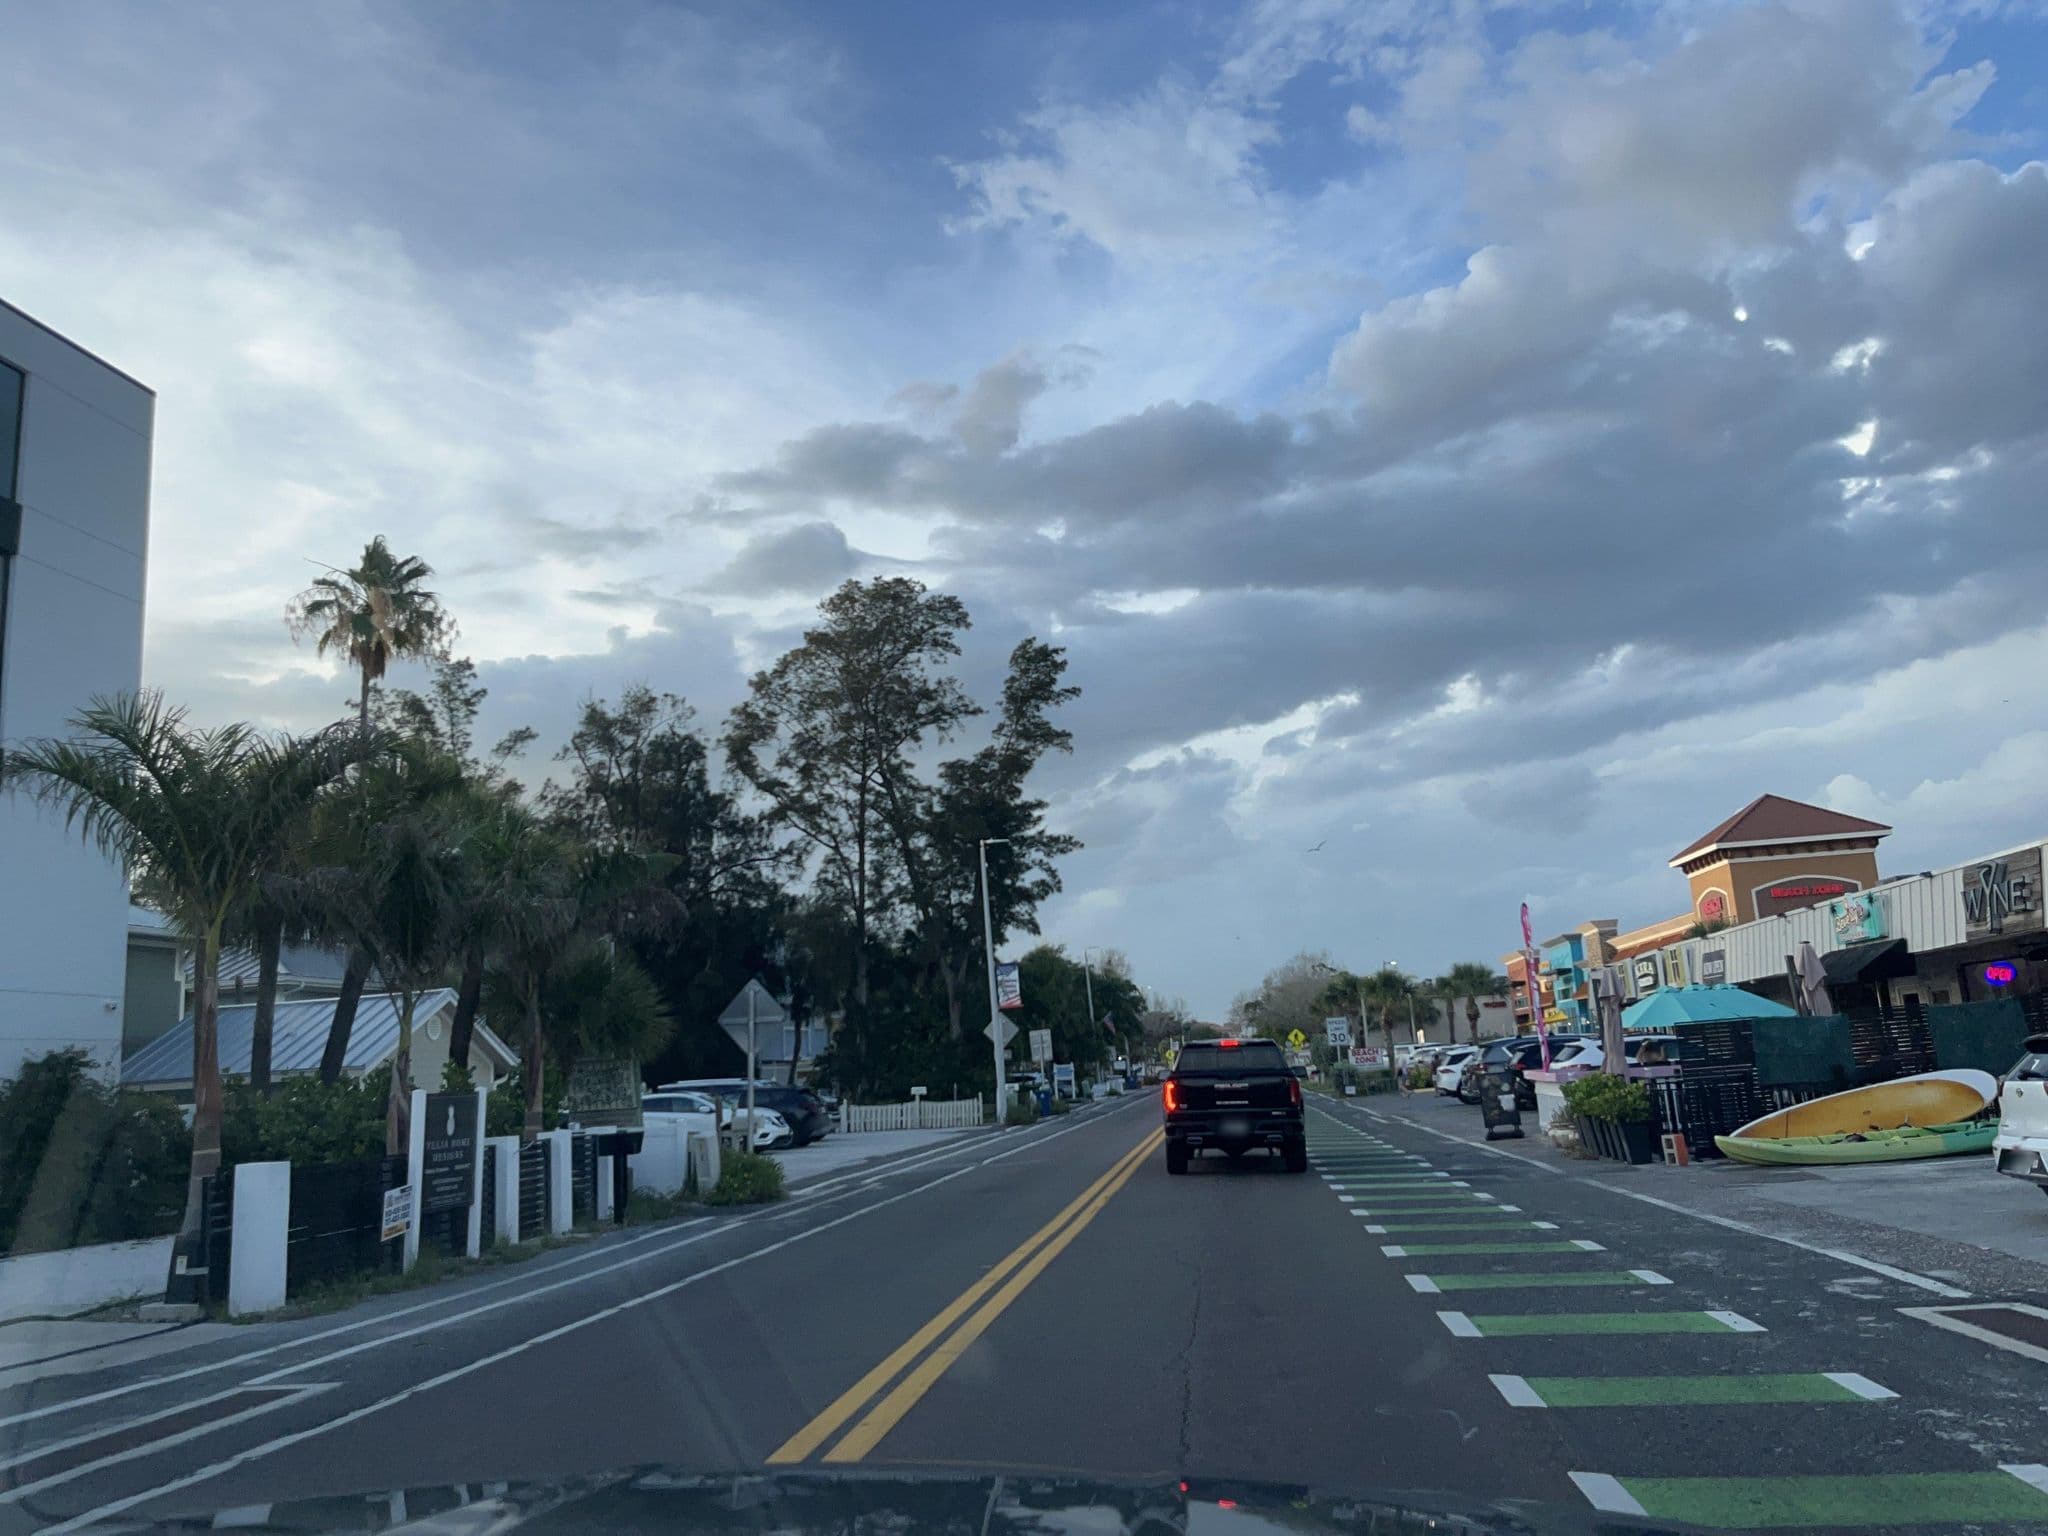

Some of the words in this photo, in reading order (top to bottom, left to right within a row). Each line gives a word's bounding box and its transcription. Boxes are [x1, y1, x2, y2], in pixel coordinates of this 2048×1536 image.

[1986, 966, 2012, 981] OPEN
[1330, 1032, 1346, 1042] 30
[1352, 1048, 1378, 1057] BEACH
[1355, 1056, 1377, 1064] ZONE
